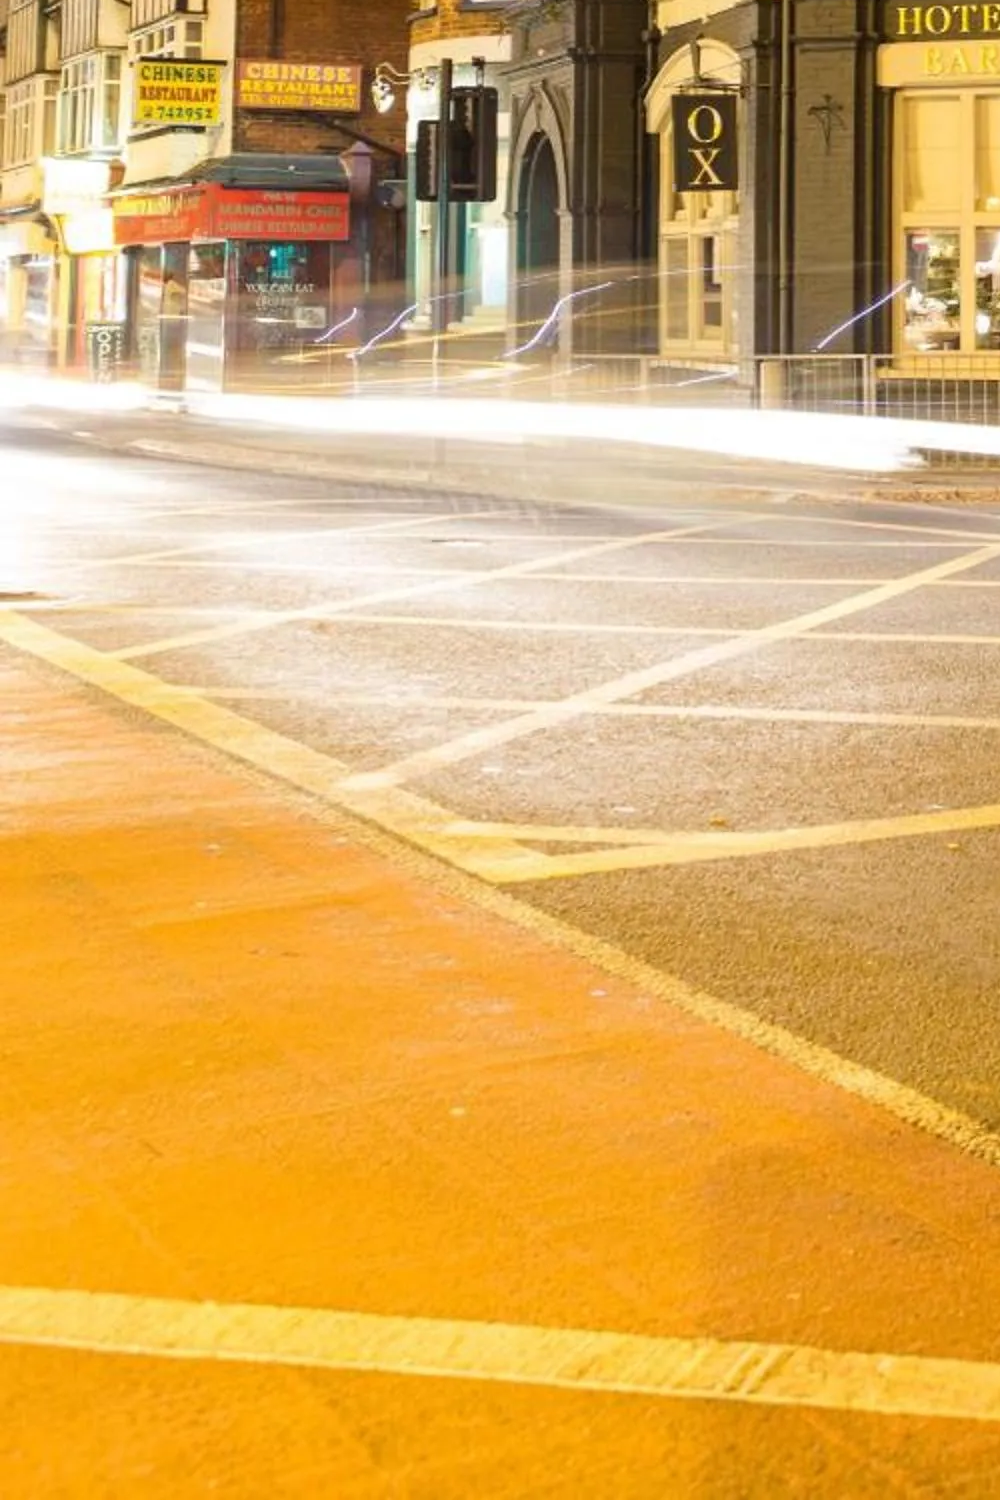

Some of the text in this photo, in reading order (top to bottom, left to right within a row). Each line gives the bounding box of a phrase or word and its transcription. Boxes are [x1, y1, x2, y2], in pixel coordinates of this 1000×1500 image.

[141, 65, 217, 83] CHINESE
[246, 63, 352, 83] CHINESE
[140, 85, 217, 102] RESTAURANT
[241, 79, 357, 97] RESTAURANT
[156, 105, 214, 120] 742952
[688, 105, 724, 185] OX
[220, 203, 302, 216] MANDARIN
[218, 220, 343, 234] CHINESE RESTAURANT
[245, 283, 315, 293] YOU CAN EAT
